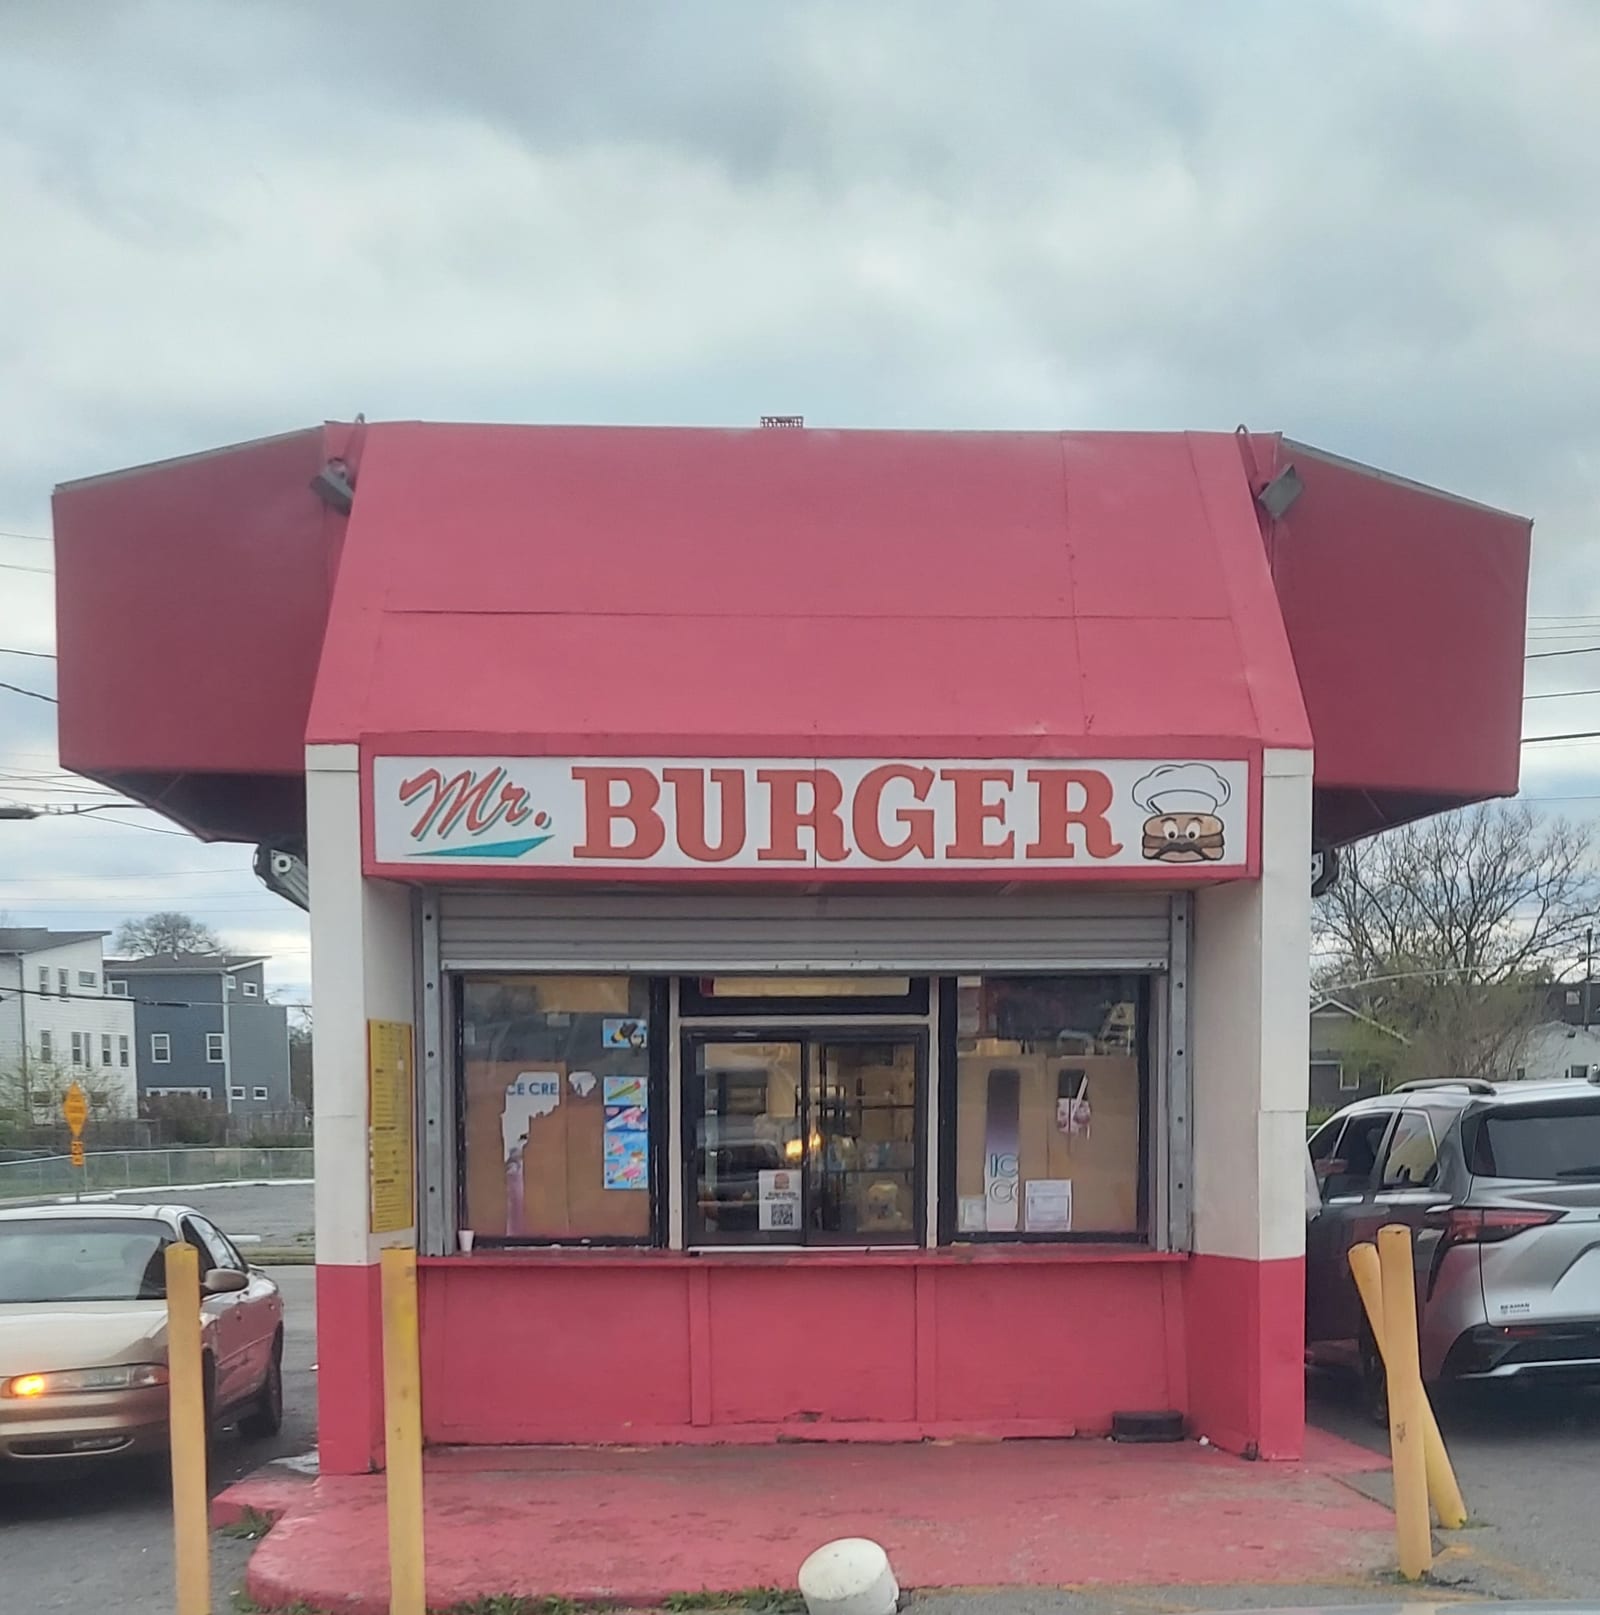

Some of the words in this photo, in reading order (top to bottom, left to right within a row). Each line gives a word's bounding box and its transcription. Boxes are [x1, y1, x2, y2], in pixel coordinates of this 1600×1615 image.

[399, 767, 552, 841] Mr.
[571, 764, 1123, 862] BURGER
[529, 1082, 558, 1095] CRE
